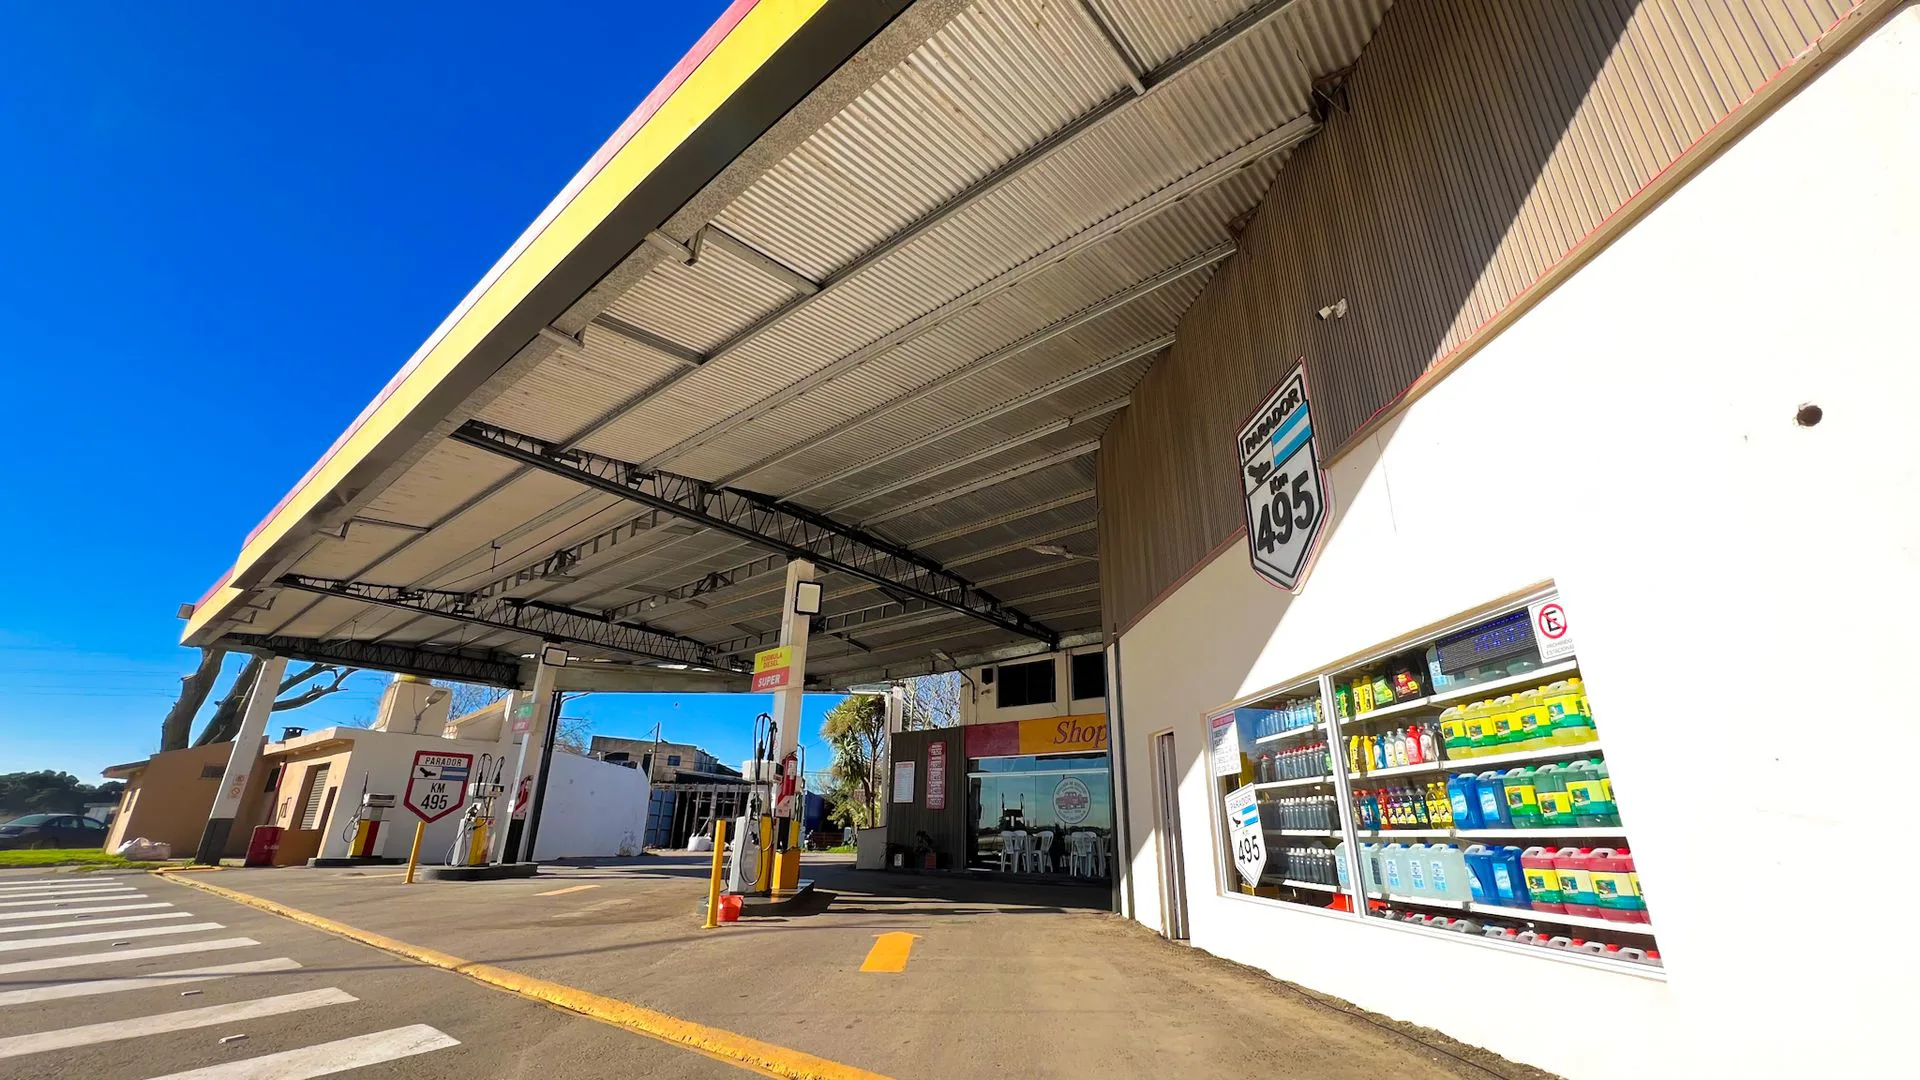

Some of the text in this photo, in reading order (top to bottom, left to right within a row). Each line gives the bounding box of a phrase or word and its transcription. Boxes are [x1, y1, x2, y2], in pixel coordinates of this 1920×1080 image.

[1244, 388, 1300, 455] PARADOR
[1269, 472, 1289, 495] Km
[1257, 470, 1314, 554] 495
[758, 673, 781, 688] SUPER
[1053, 719, 1107, 749] Shop
[425, 756, 462, 767] PARADOR
[430, 782, 446, 794] KM
[420, 794, 449, 810] 495
[1230, 794, 1252, 811] PARADOR
[1238, 835, 1260, 864] 495
